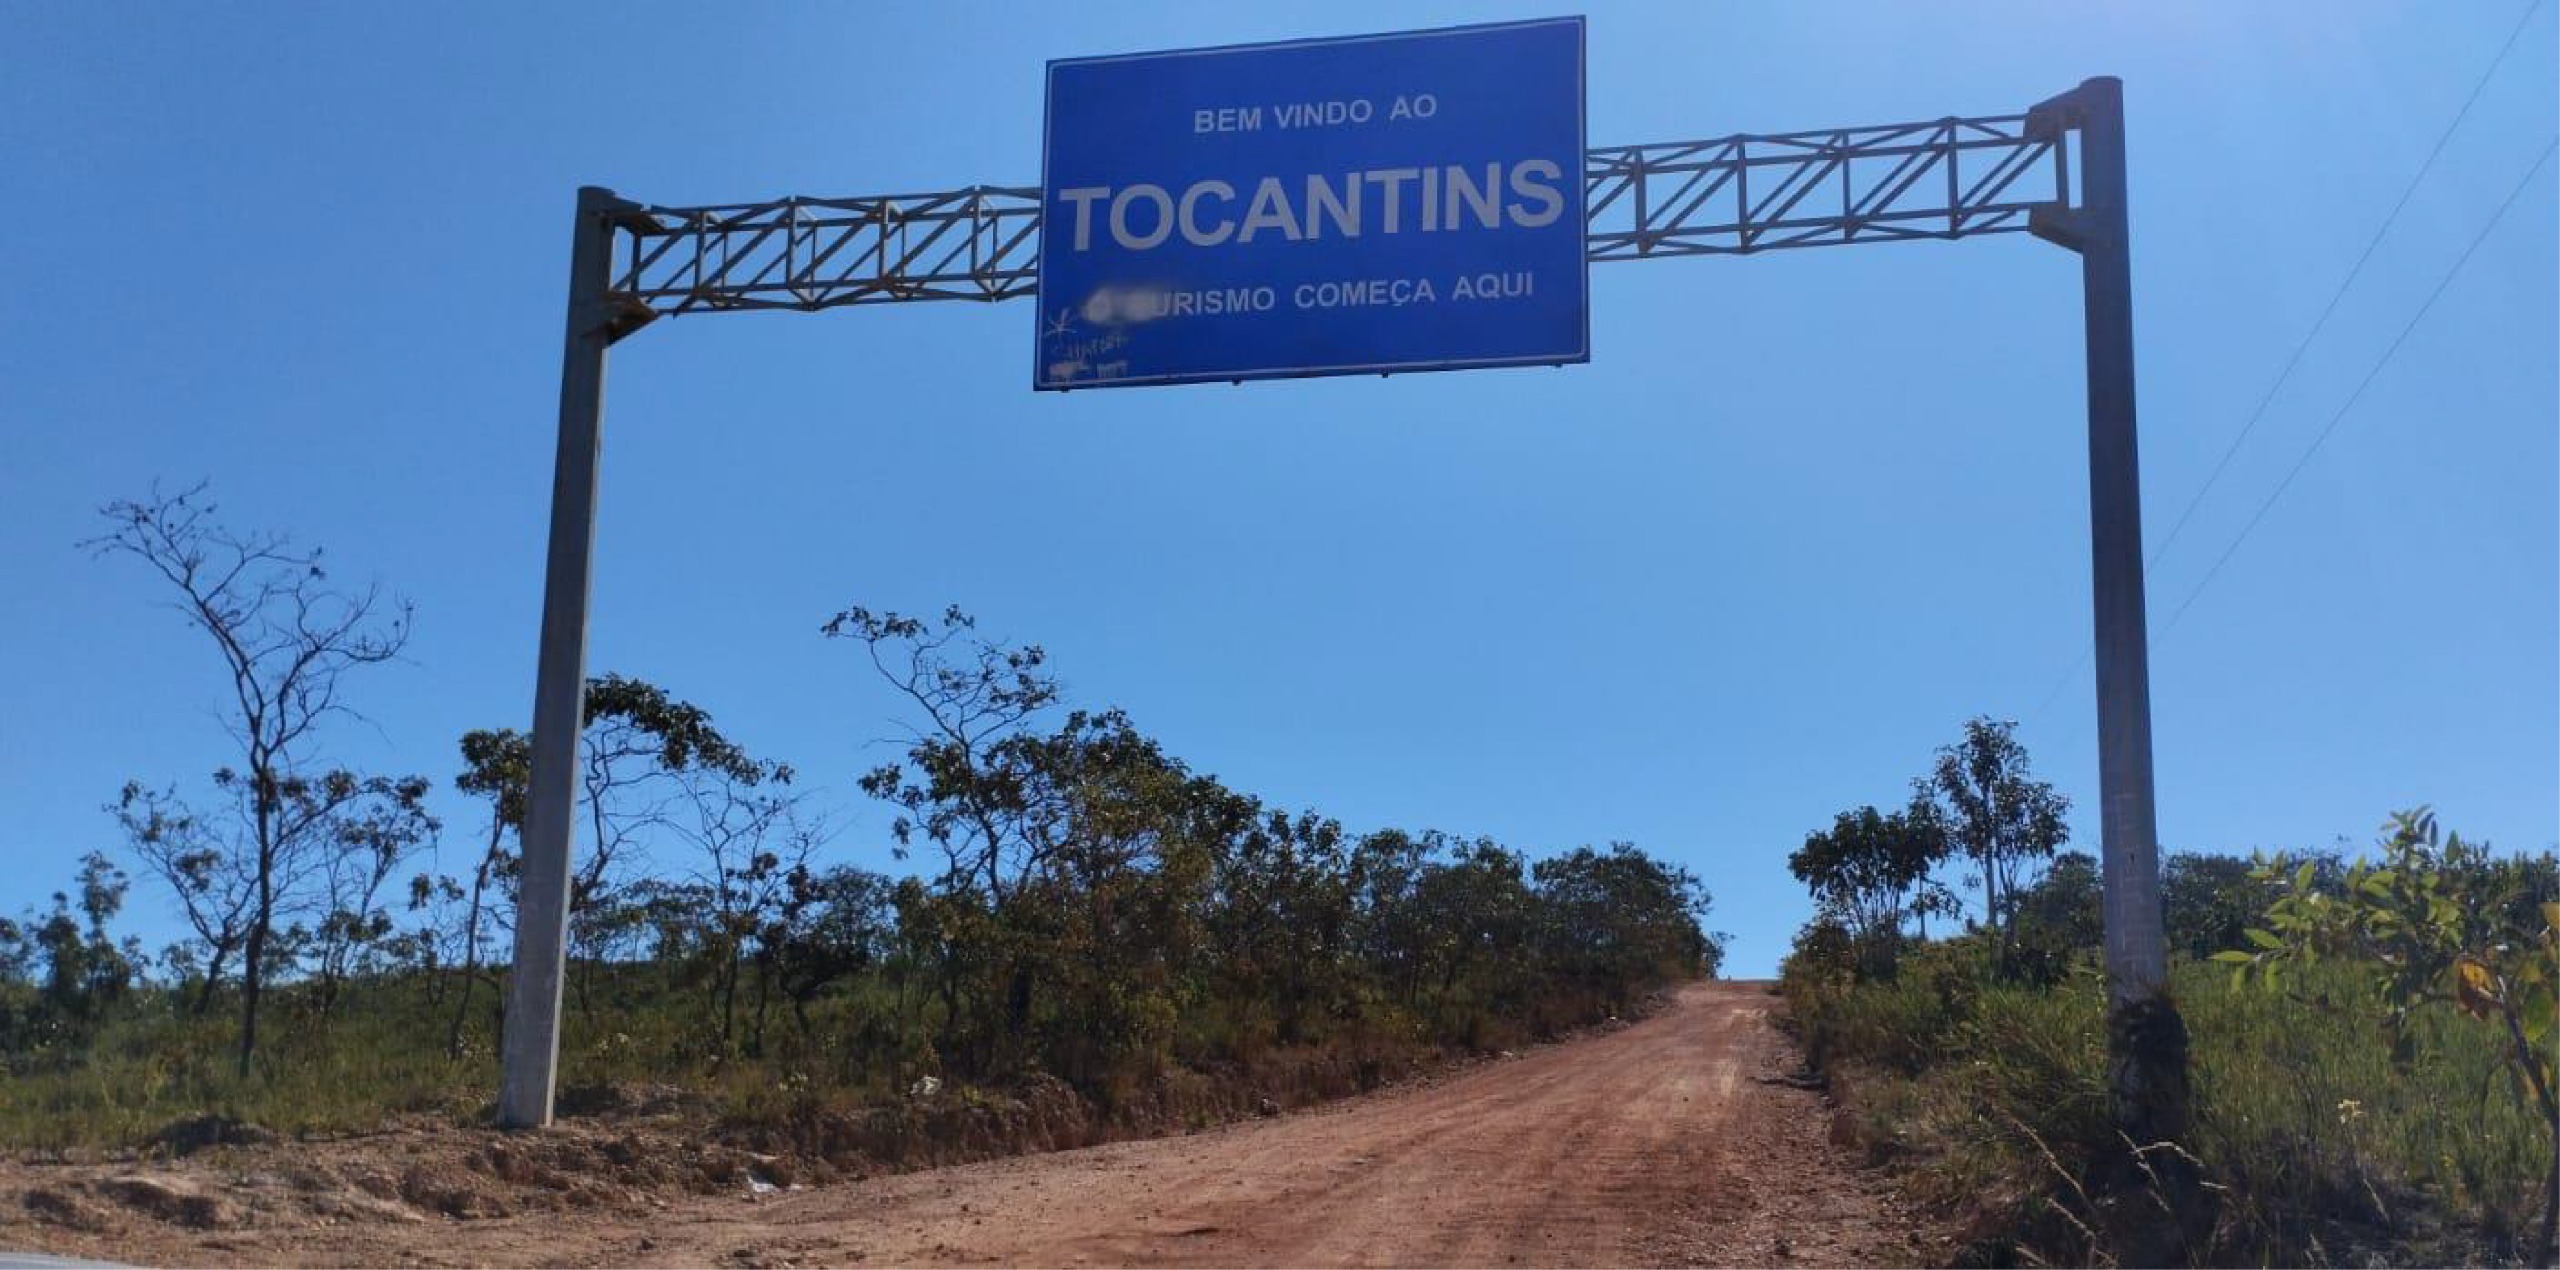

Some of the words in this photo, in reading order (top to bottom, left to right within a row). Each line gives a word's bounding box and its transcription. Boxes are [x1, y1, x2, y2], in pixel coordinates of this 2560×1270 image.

[1194, 108, 1262, 133] BEM
[1273, 99, 1373, 129] VINDO
[1389, 94, 1437, 121] AO
[1059, 158, 1565, 252] TOCANTINS
[1129, 286, 1276, 319] URISMO
[1294, 278, 1435, 309] COMEÇA
[1451, 271, 1534, 301] AQUI
